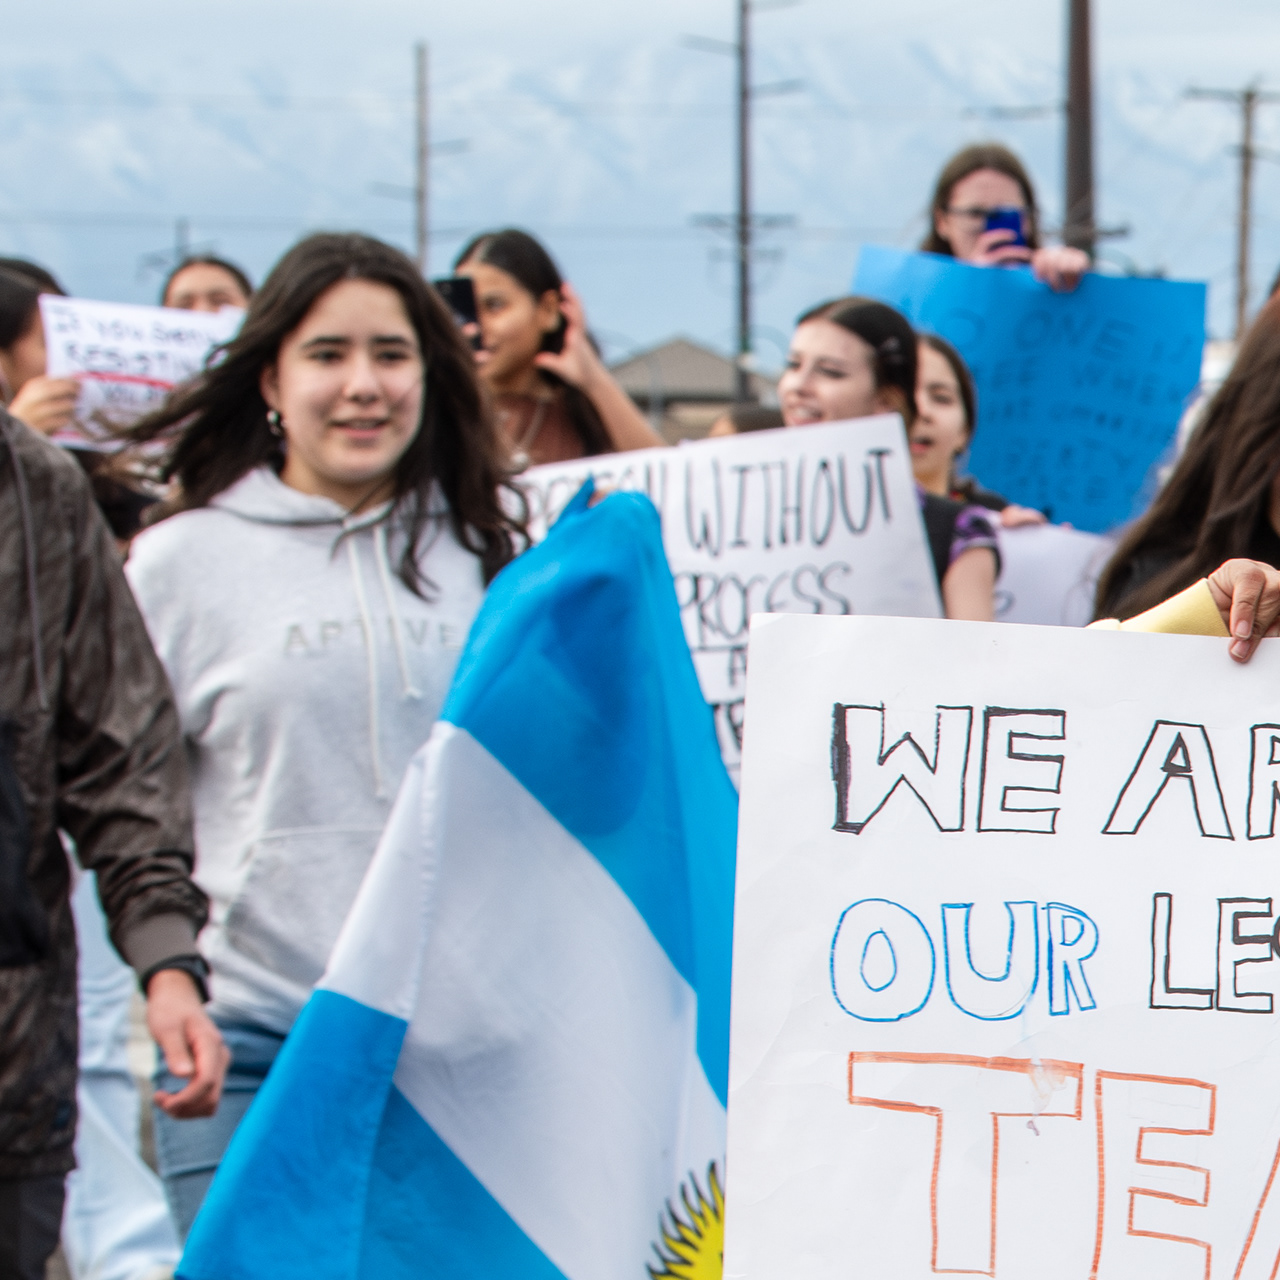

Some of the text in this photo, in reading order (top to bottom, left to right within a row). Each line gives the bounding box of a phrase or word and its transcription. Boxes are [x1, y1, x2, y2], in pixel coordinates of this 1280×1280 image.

[685, 446, 895, 557] WITHOUT
[830, 702, 1067, 835] WE
[829, 897, 1099, 1022] OUR
